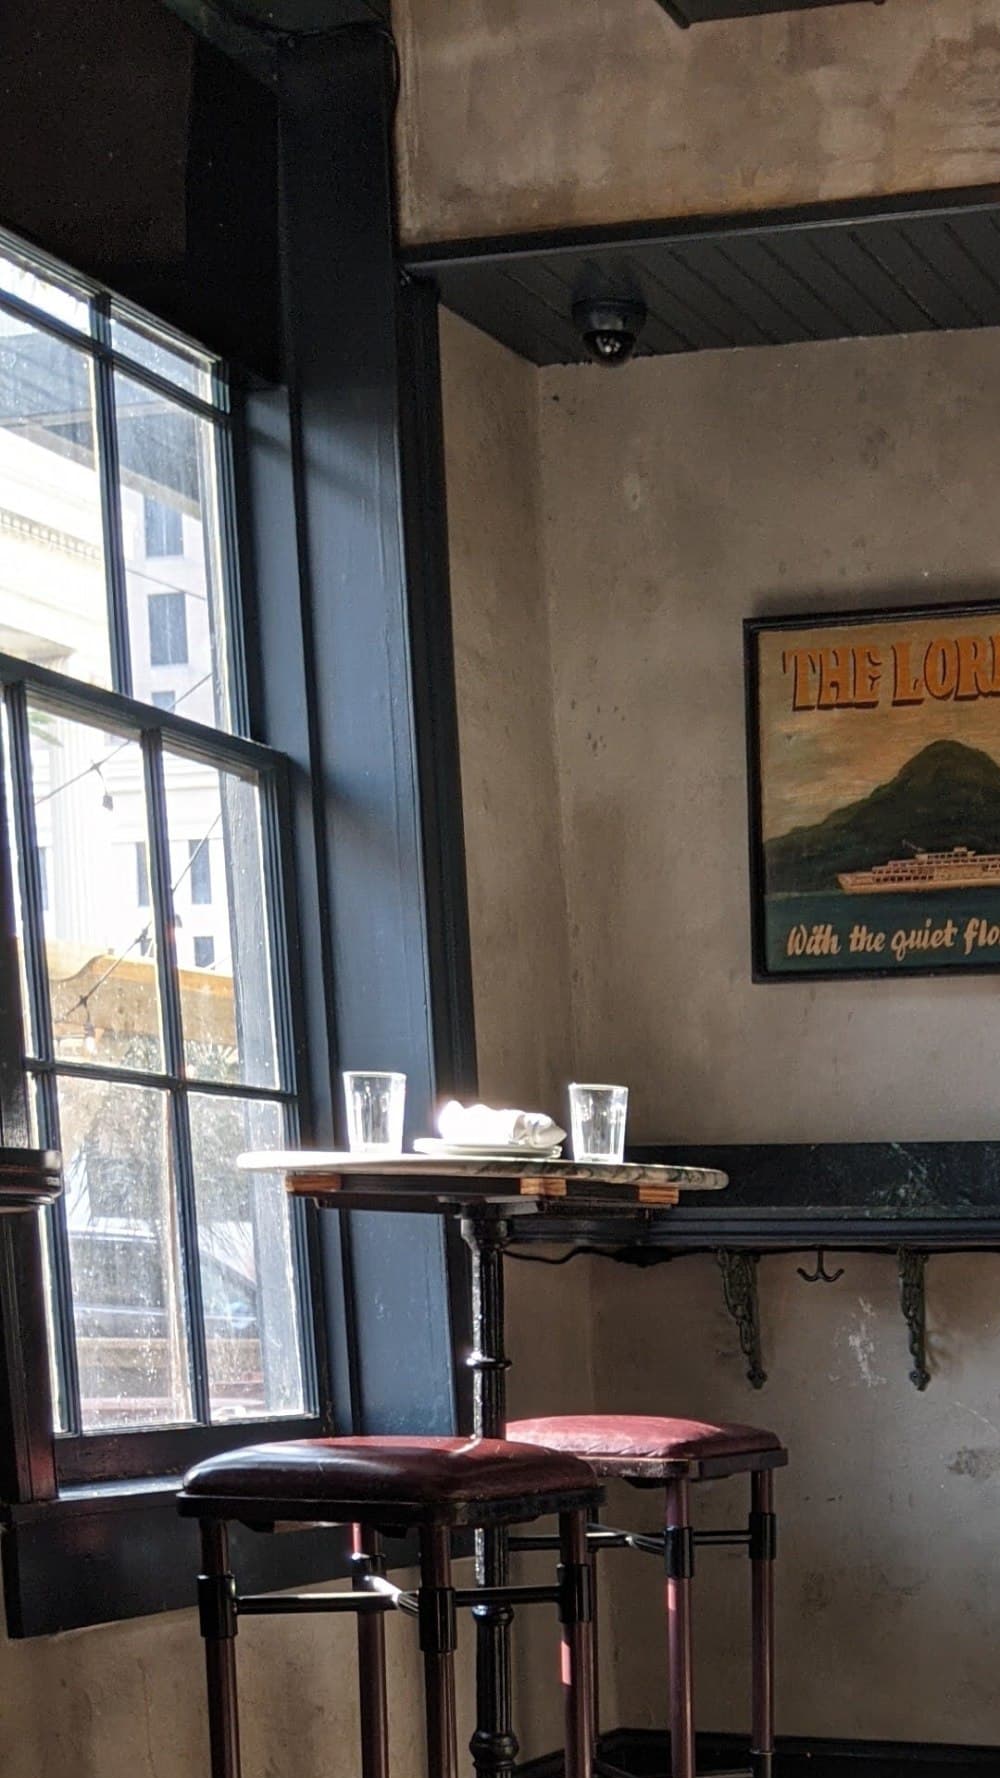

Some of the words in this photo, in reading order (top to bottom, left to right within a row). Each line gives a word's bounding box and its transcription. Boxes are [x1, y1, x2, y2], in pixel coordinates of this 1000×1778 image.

[782, 644, 881, 712] THE
[787, 923, 840, 958] With
[850, 925, 885, 953] the
[891, 918, 956, 960] quiet
